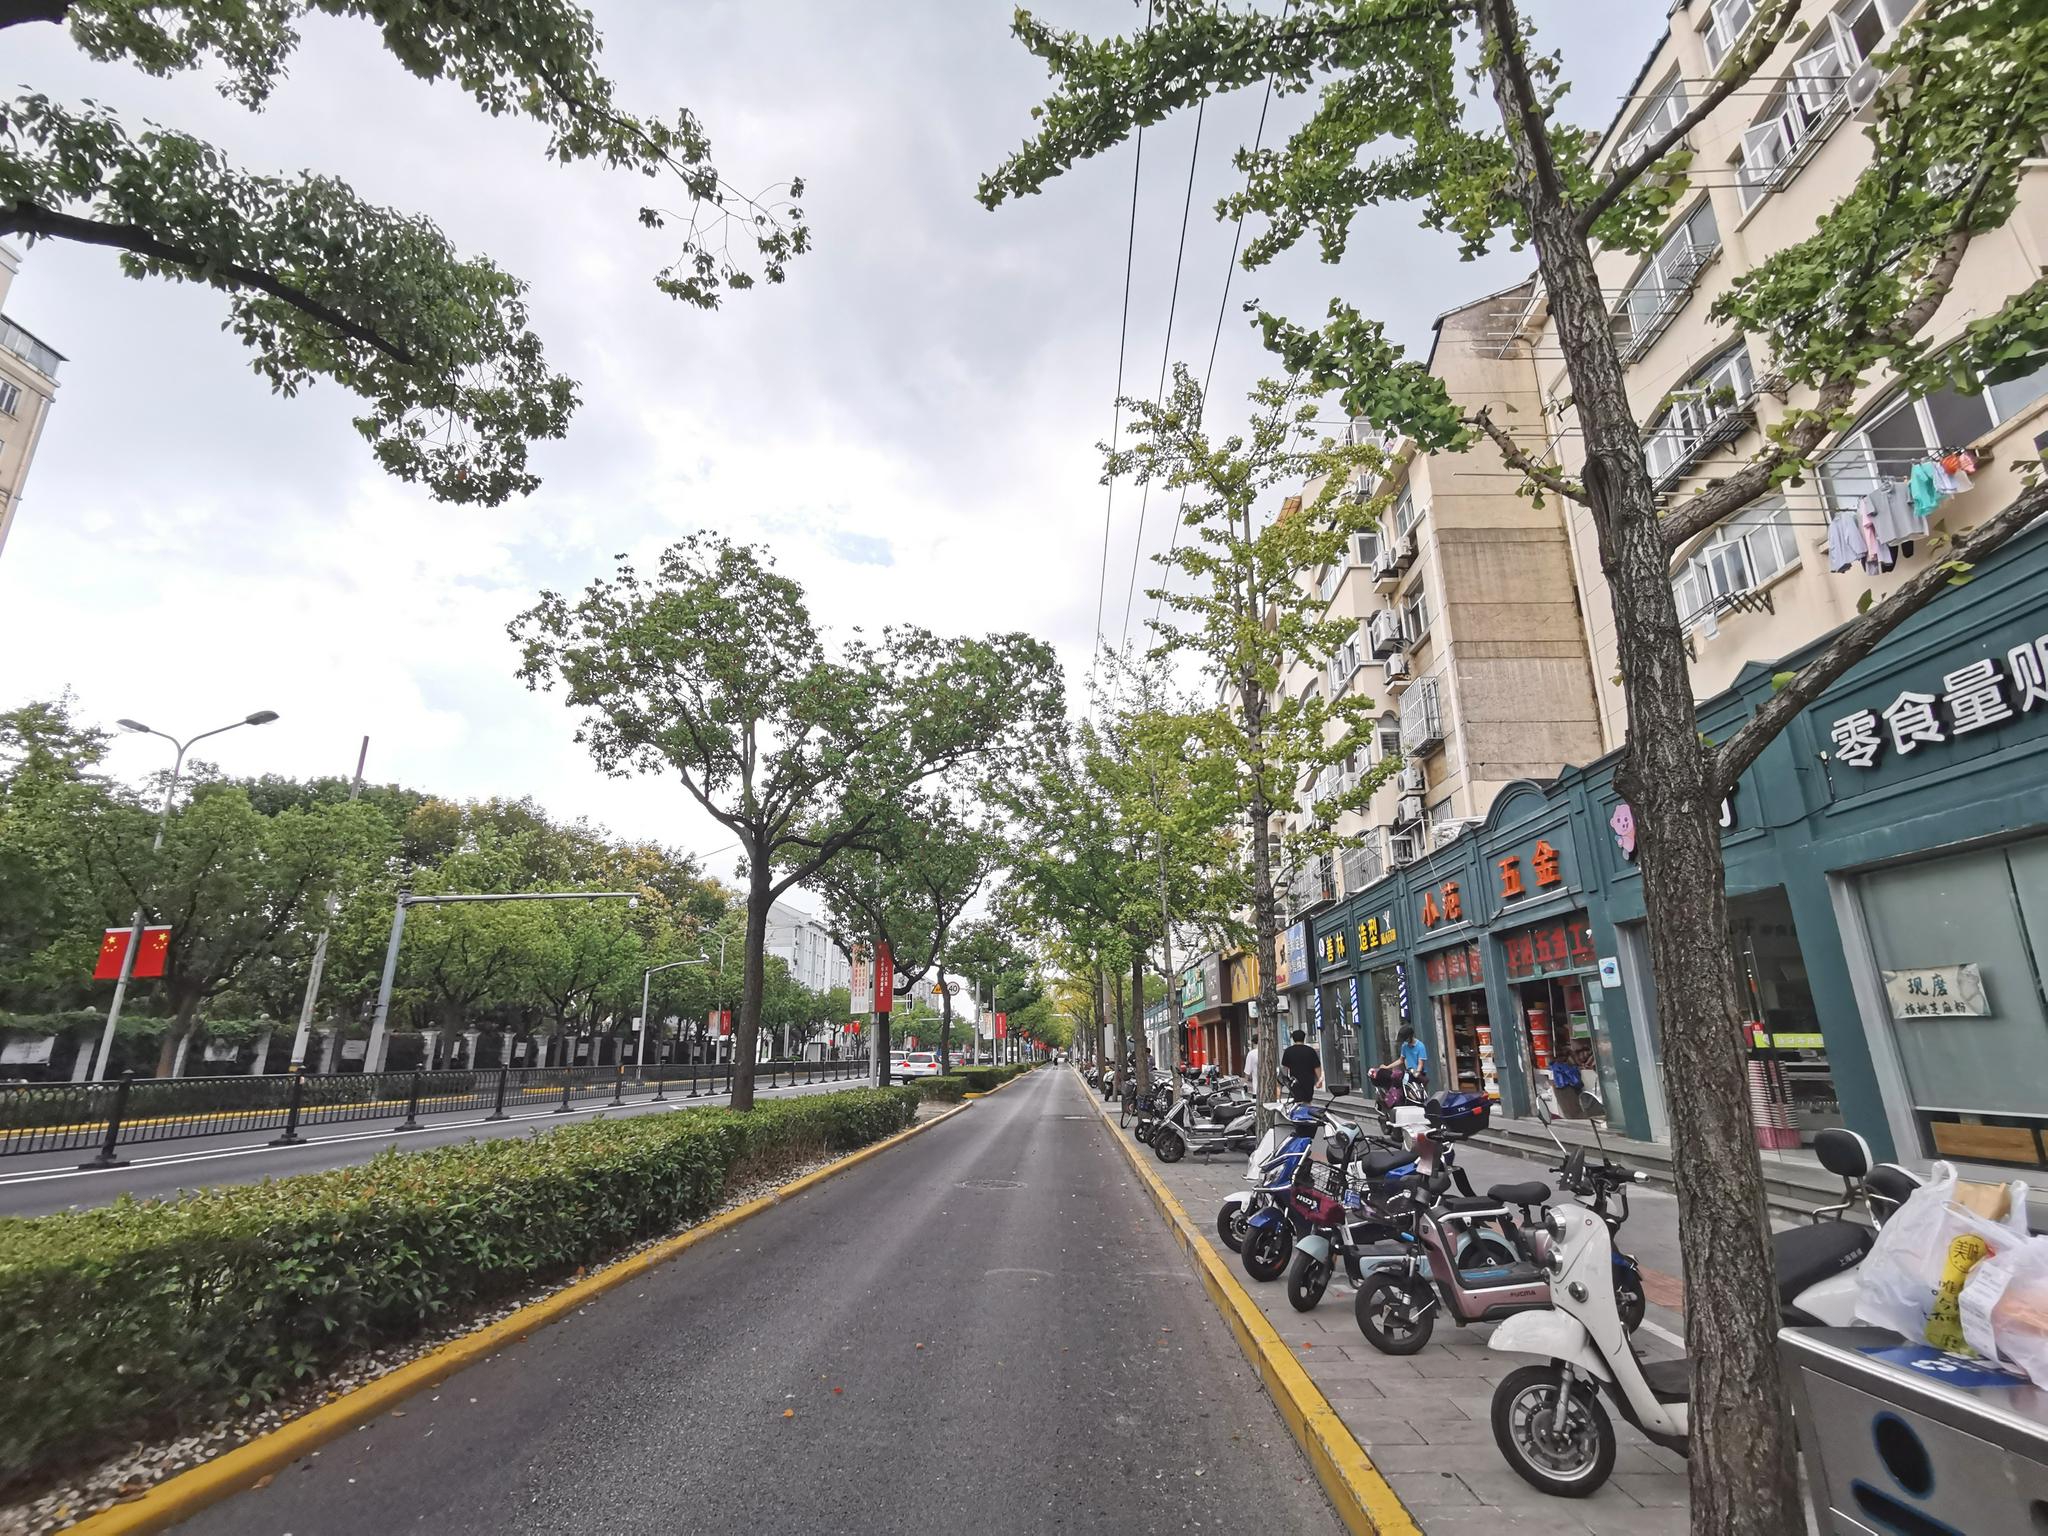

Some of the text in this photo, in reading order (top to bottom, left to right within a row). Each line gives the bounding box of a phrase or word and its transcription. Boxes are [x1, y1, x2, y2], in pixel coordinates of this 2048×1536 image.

[1497, 840, 1562, 897] 五金
[948, 985, 958, 993] 40
[1907, 974, 1949, 997] 现磨
